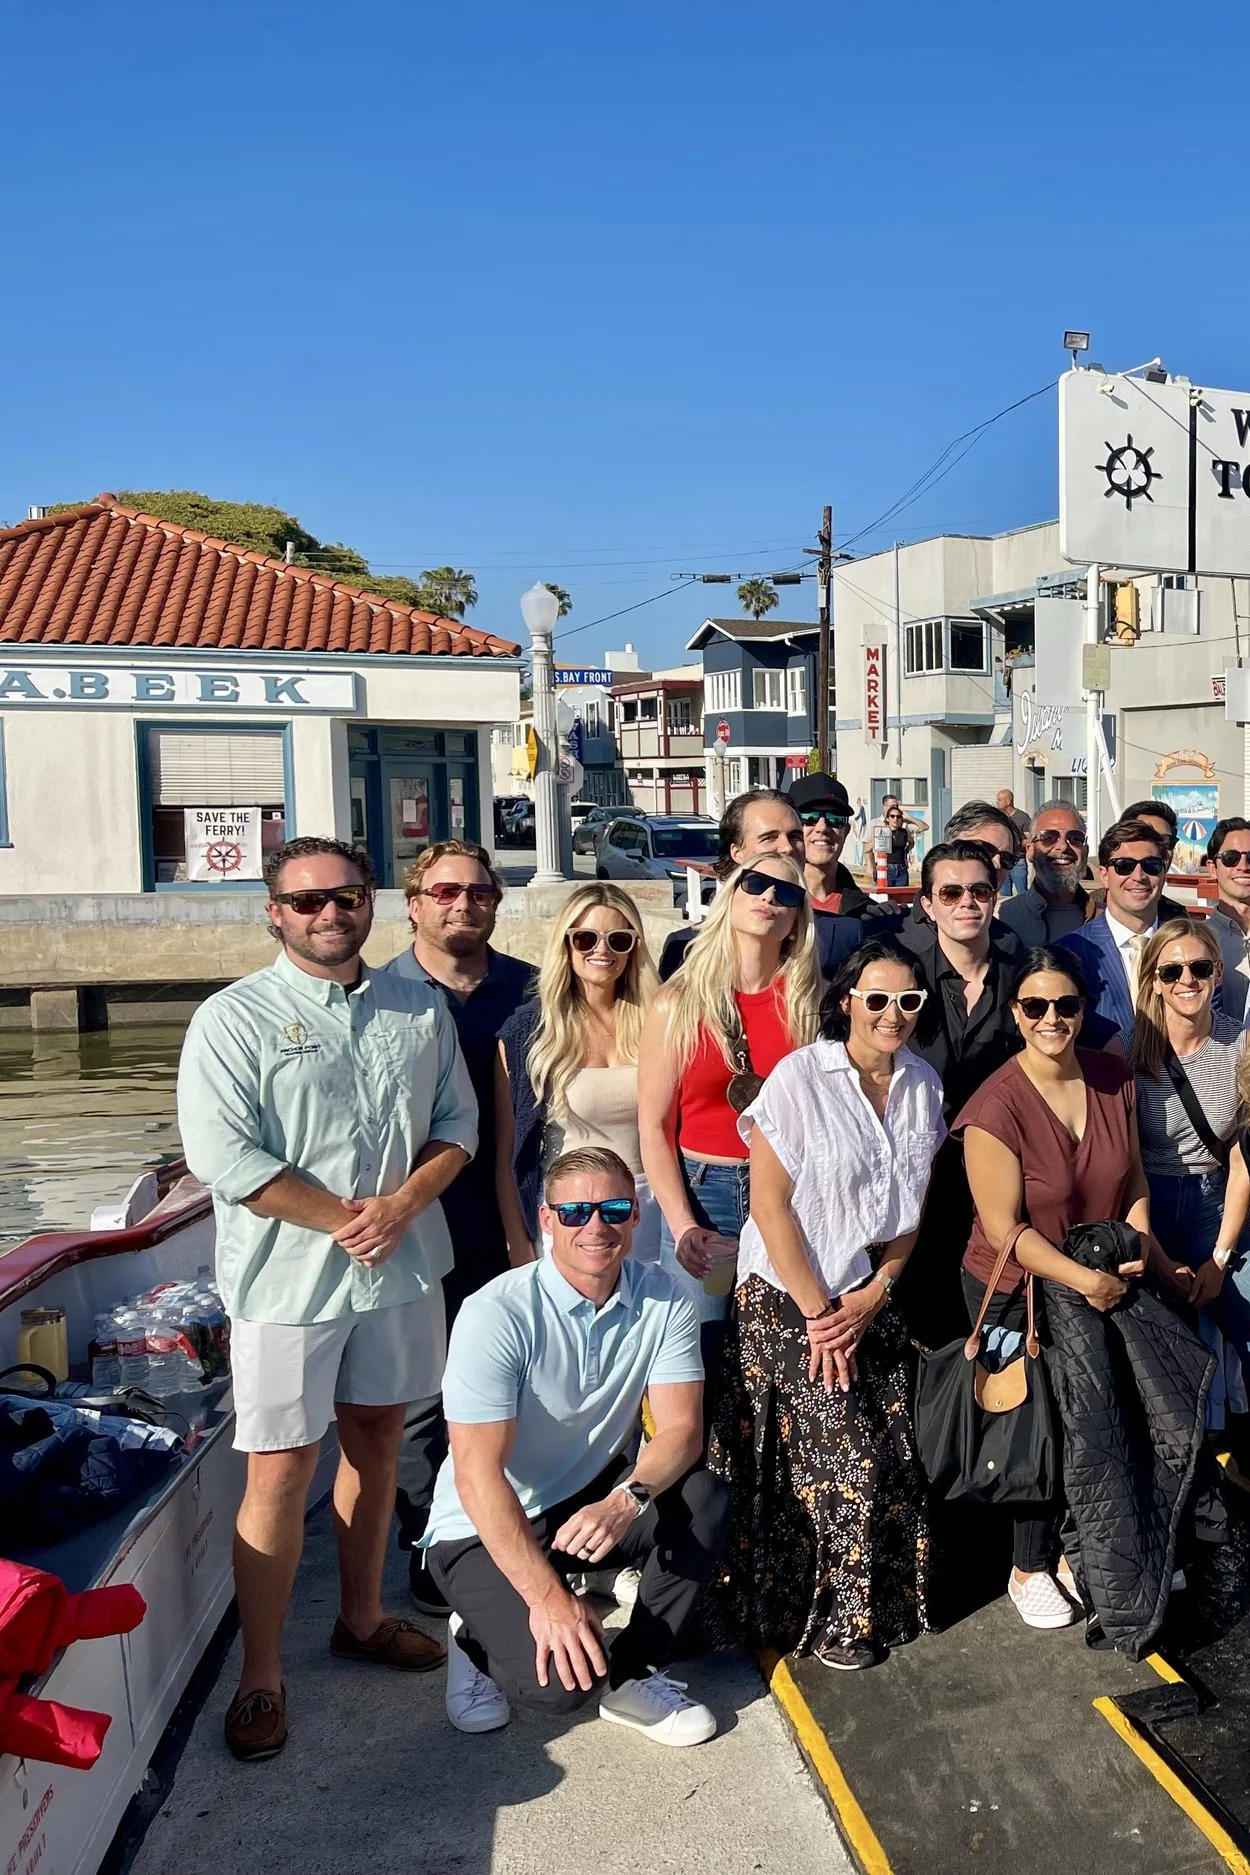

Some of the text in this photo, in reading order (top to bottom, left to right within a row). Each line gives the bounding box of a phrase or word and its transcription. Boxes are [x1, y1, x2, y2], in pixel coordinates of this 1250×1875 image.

[584, 671, 612, 683] FRONT
[866, 647, 880, 739] MARKET
[196, 811, 250, 823] SAVE THE
[205, 825, 245, 836] FERRY!
